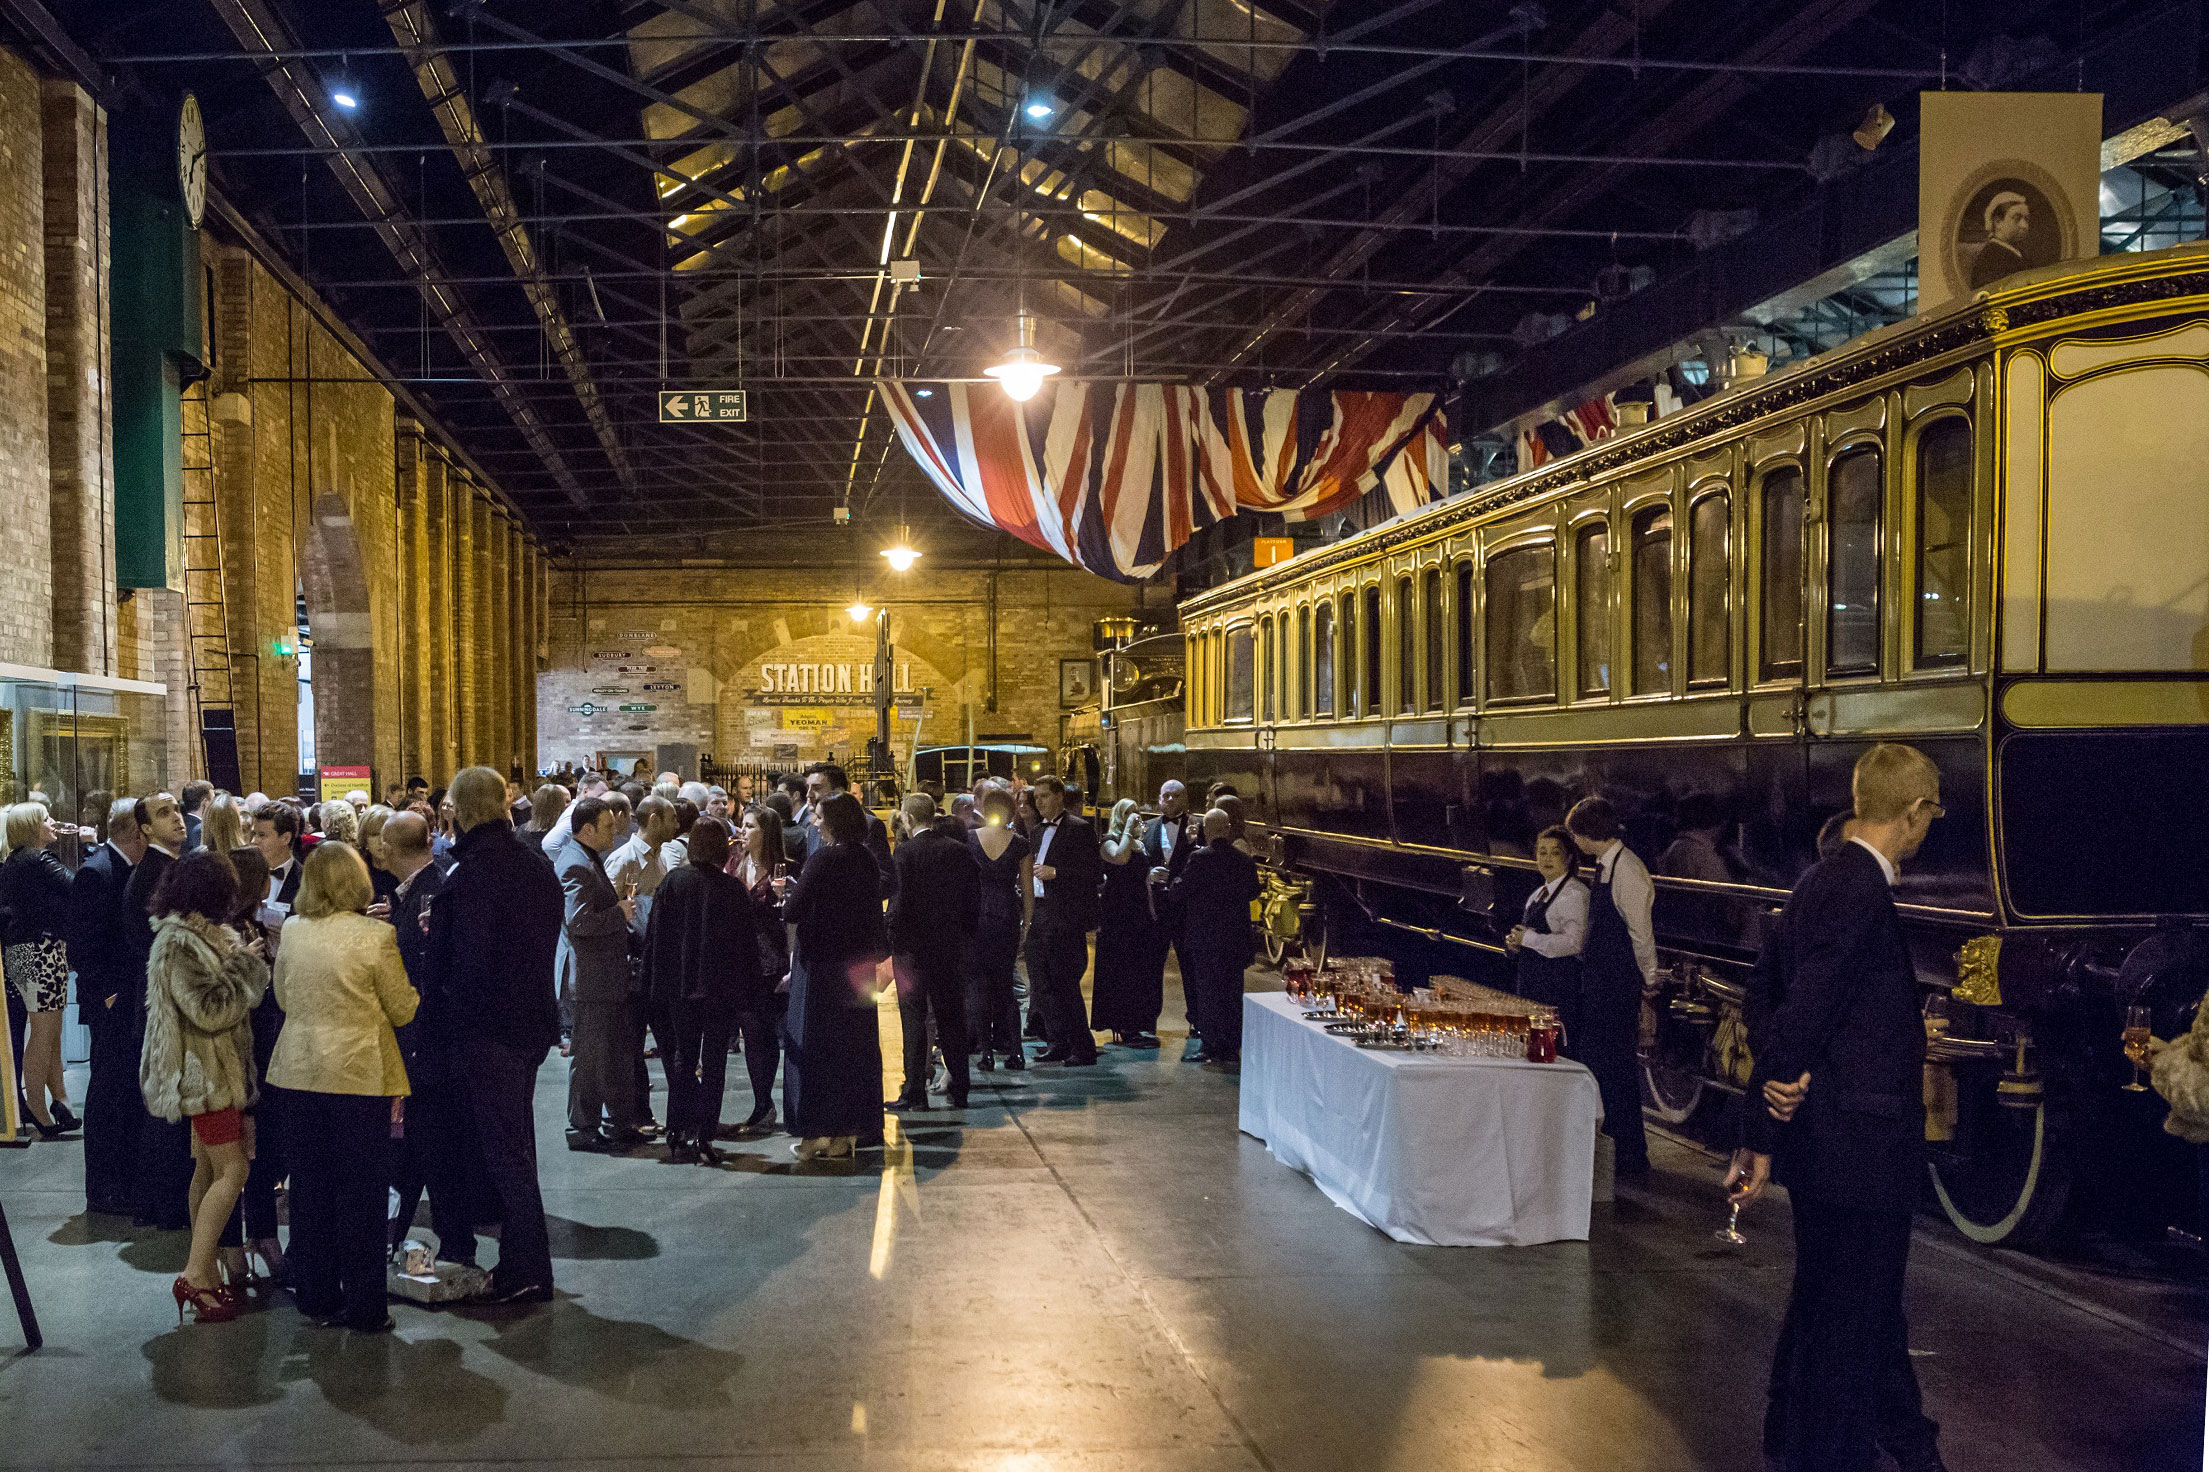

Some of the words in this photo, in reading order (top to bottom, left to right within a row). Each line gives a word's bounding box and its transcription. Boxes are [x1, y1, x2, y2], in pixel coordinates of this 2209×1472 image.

[719, 395, 740, 403] FIRE
[719, 409, 740, 417] EXIT
[761, 663, 853, 693] STATION
[859, 663, 916, 693] HLL
